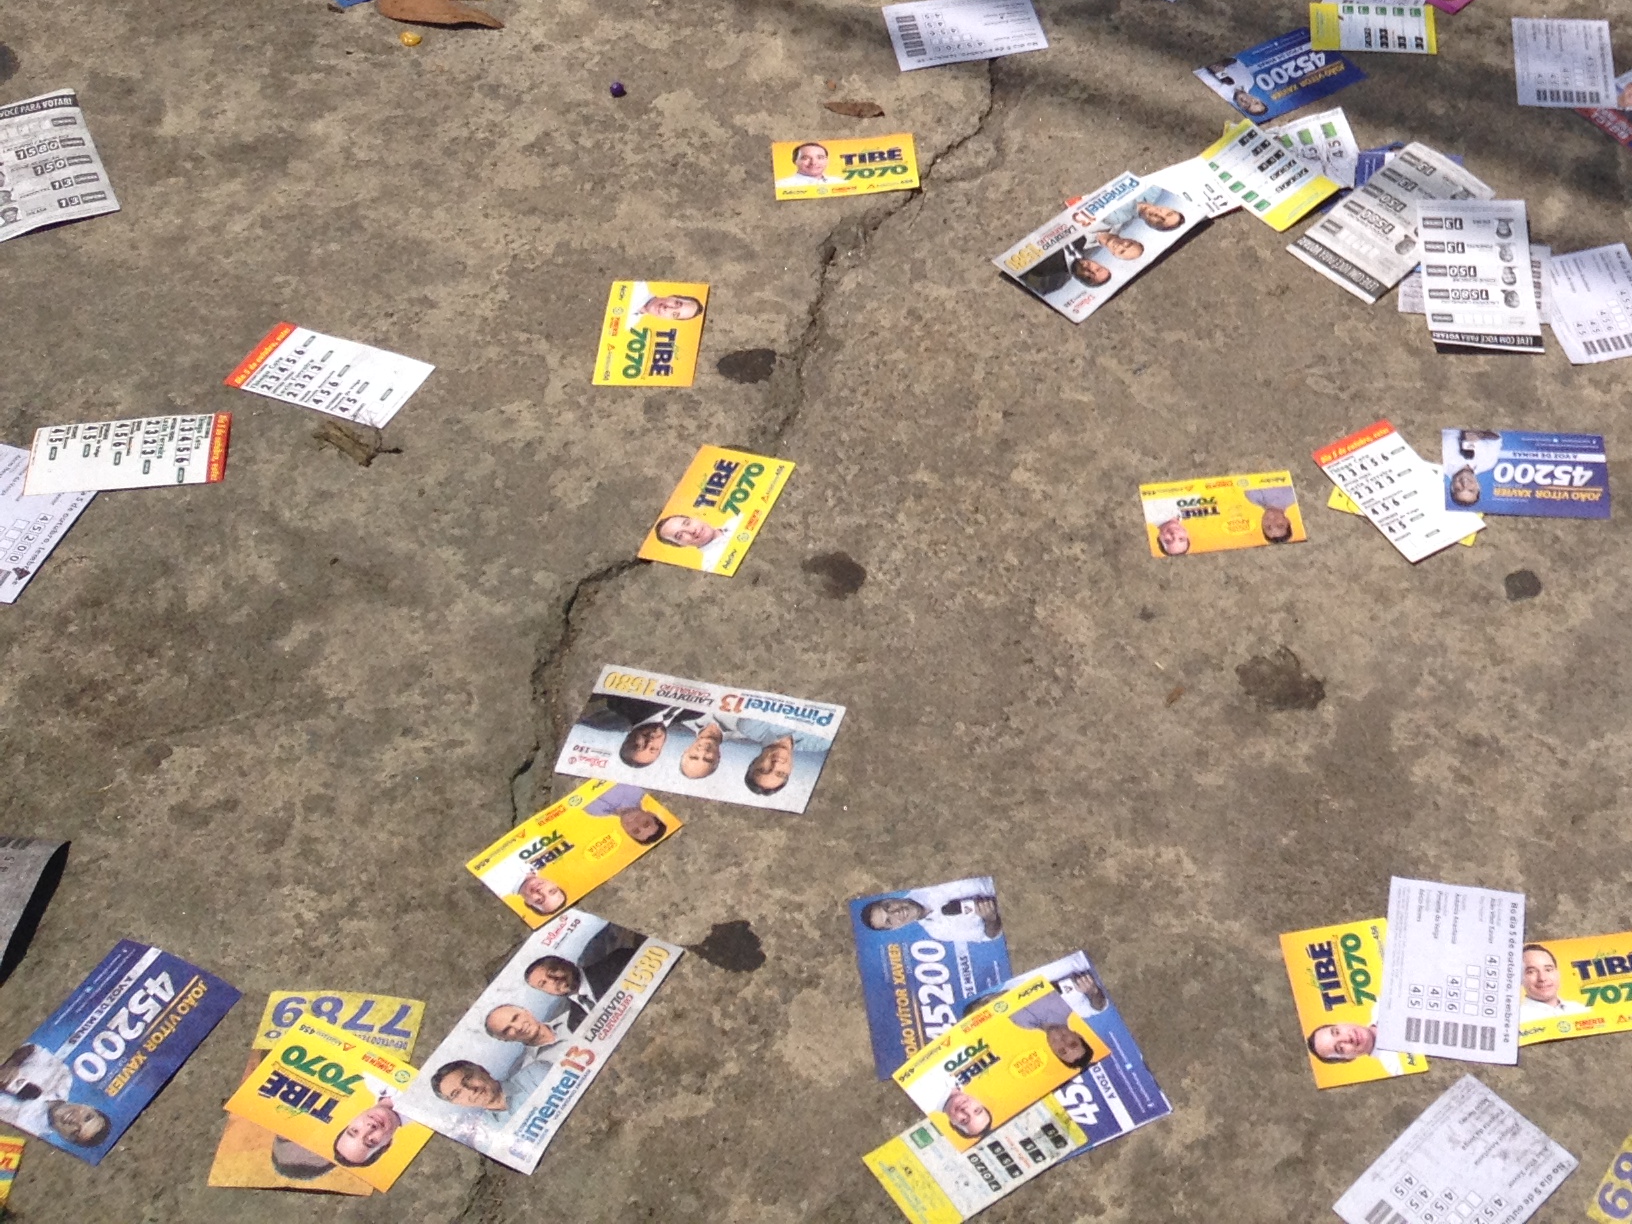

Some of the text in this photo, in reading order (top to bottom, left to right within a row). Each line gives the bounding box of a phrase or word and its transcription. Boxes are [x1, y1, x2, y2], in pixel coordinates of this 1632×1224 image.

[1255, 52, 1326, 91] 45200
[33, 159, 66, 176] 150
[51, 177, 73, 190] 13
[843, 164, 908, 180] 7070
[57, 196, 80, 209] 13
[622, 328, 648, 379] 7070
[719, 463, 765, 515] 7070
[1494, 463, 1594, 487] 45200
[605, 671, 656, 696] 1580
[518, 830, 563, 860] 7070
[622, 945, 670, 994] 1580
[887, 943, 907, 983] XAVIER
[1341, 933, 1377, 1006] 7070
[910, 940, 957, 1040] 5200
[74, 971, 175, 1082] 45200
[271, 995, 412, 1039] 7789
[281, 1045, 365, 1096] 7070
[944, 1038, 990, 1072] 7070
